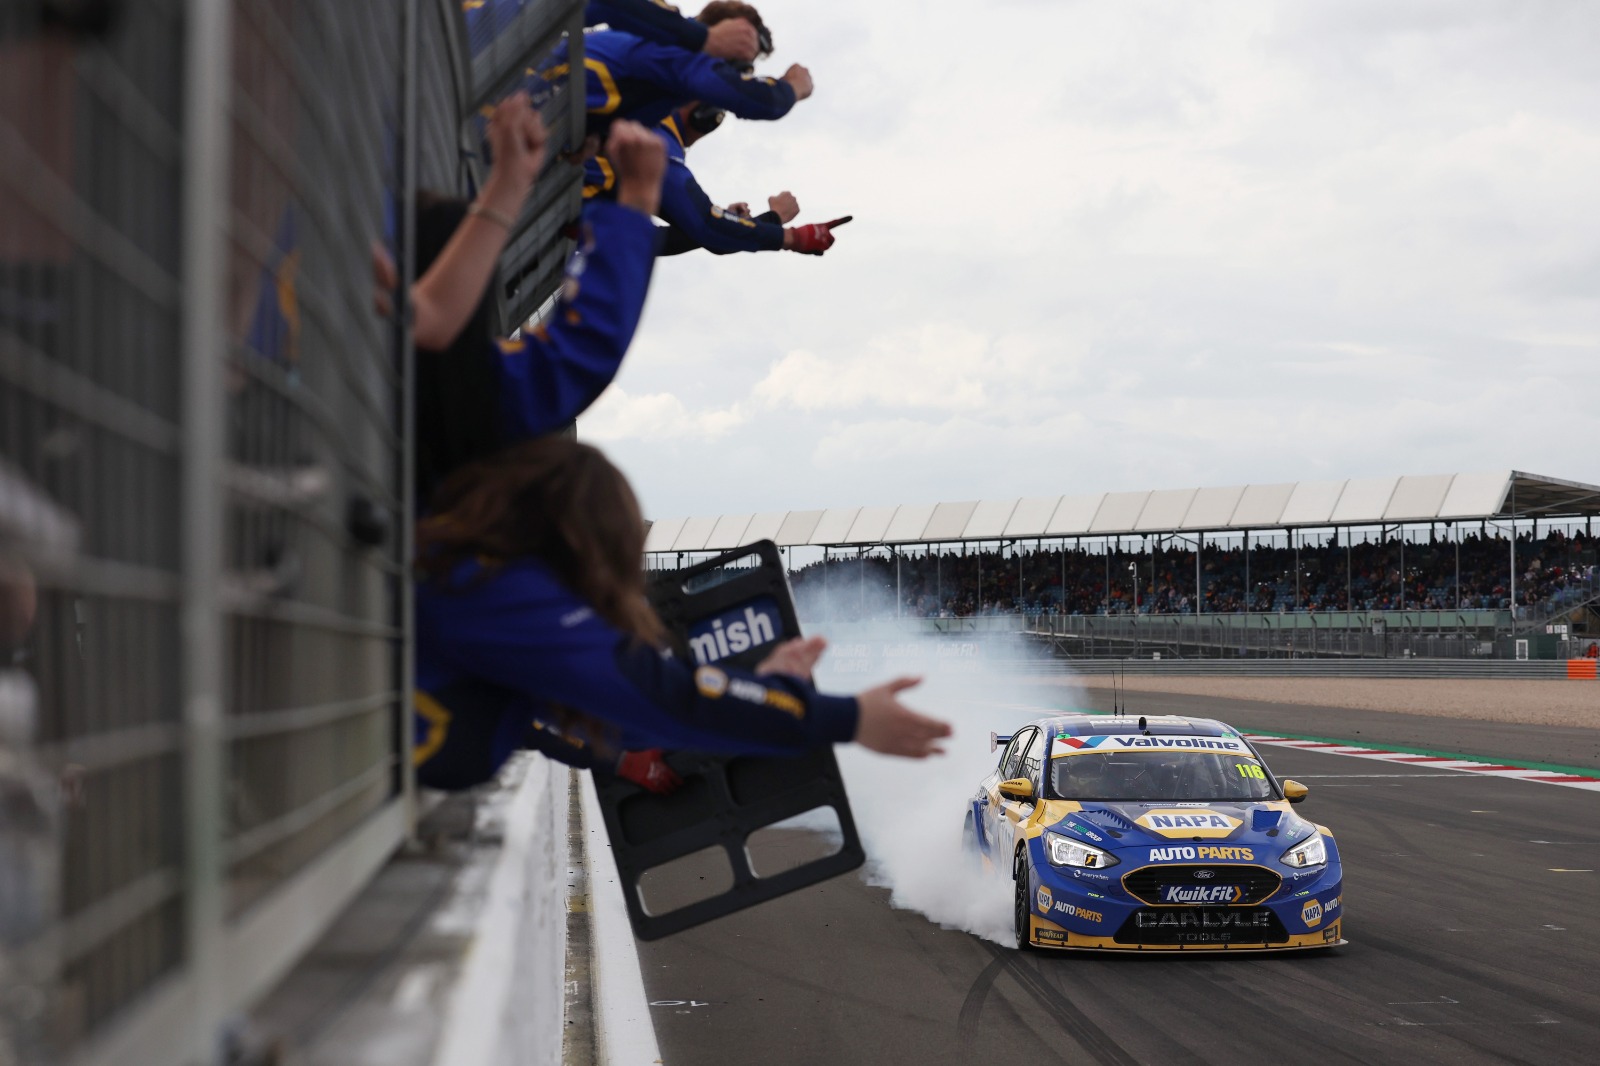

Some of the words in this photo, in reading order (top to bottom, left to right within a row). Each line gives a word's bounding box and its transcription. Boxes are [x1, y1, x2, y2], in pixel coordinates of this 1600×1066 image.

[1114, 737, 1239, 750] Valvoline
[1235, 763, 1265, 779] 116
[1151, 815, 1229, 828] NAPA
[1149, 846, 1196, 861] AUTO
[1197, 846, 1254, 861] PARTS
[1166, 886, 1233, 902] KwikFit
[1054, 901, 1076, 915] AUTO
[1075, 907, 1103, 923] PARTS
[1304, 905, 1321, 921] NAPA
[1324, 897, 1338, 913] AUTO
[1135, 911, 1270, 928] CARLYLE
[1177, 932, 1231, 941] TOOLS
